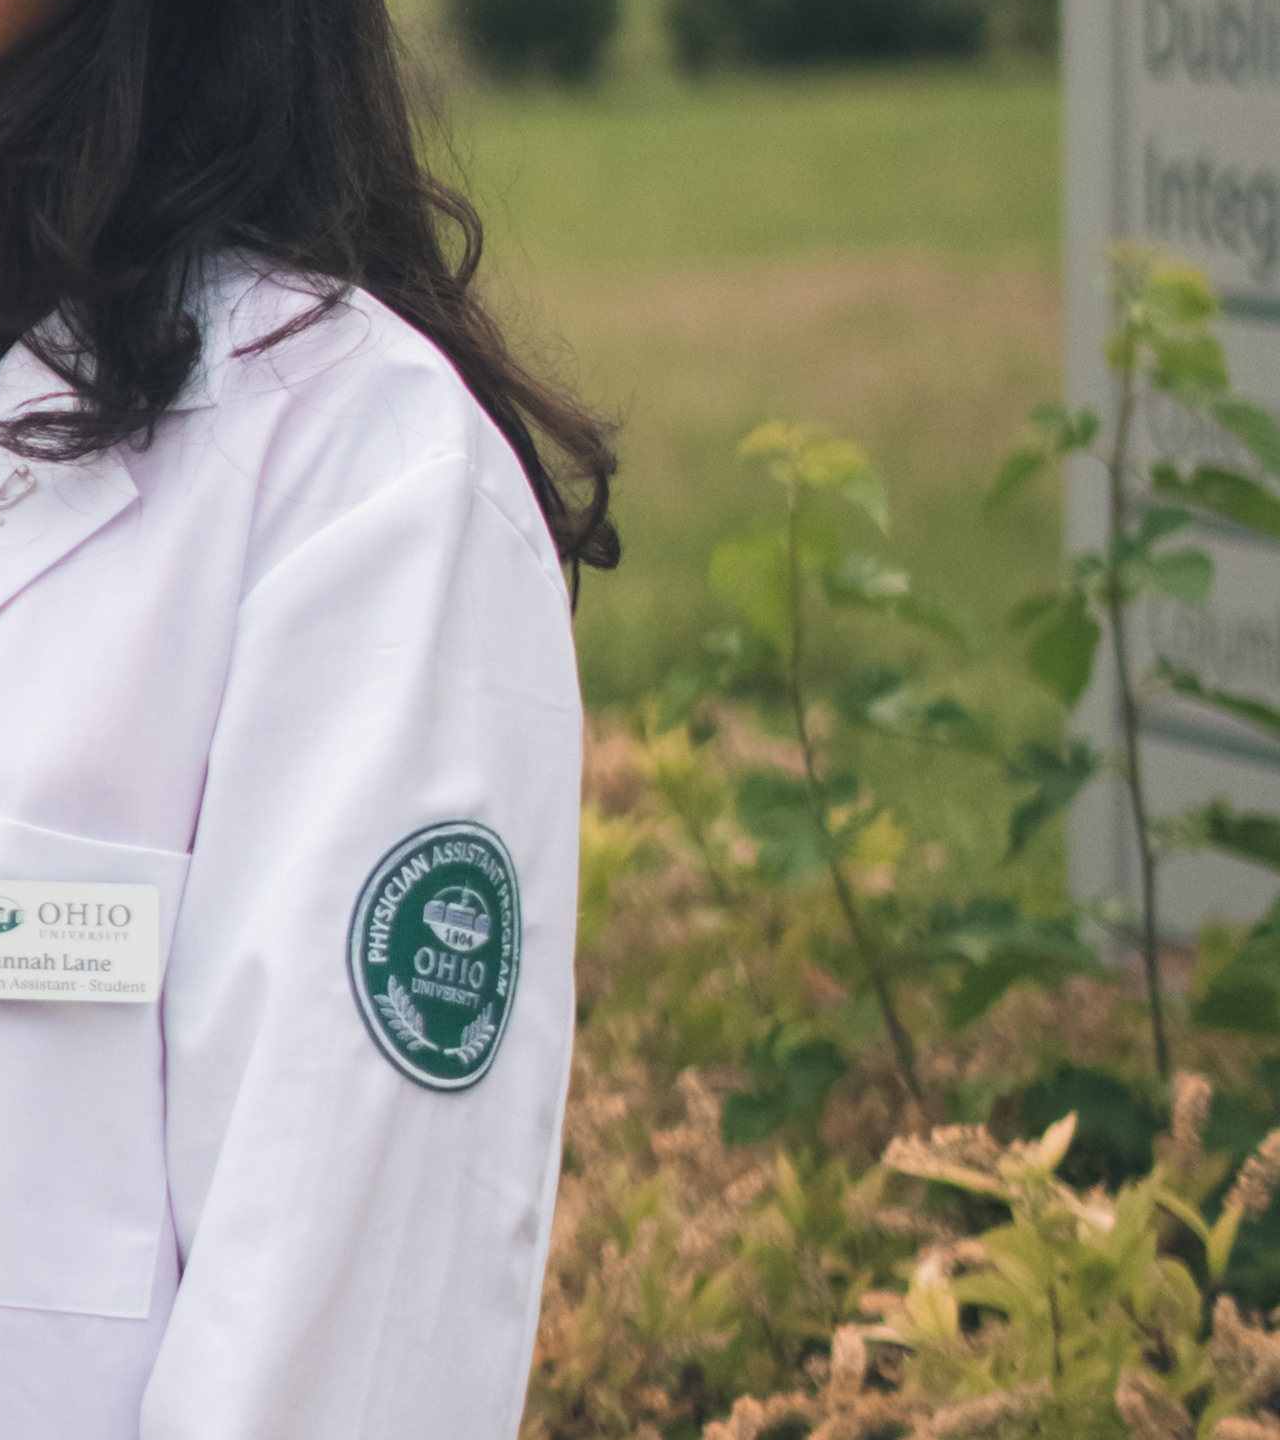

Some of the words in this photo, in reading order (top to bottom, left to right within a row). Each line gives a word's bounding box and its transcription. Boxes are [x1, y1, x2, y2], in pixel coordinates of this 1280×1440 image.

[37, 901, 131, 927] OHIO
[367, 853, 431, 963] PHYSICIAN
[432, 841, 505, 887] ASSISTANT
[496, 883, 511, 997] PROGRAM
[39, 929, 129, 941] UNIVERSITY
[444, 928, 474, 948] 1804
[62, 954, 112, 972] Lane
[414, 947, 486, 989] OHIO
[10, 977, 77, 992] Assistant
[89, 979, 147, 993] Student
[411, 977, 480, 1009] UNIVERSITY
